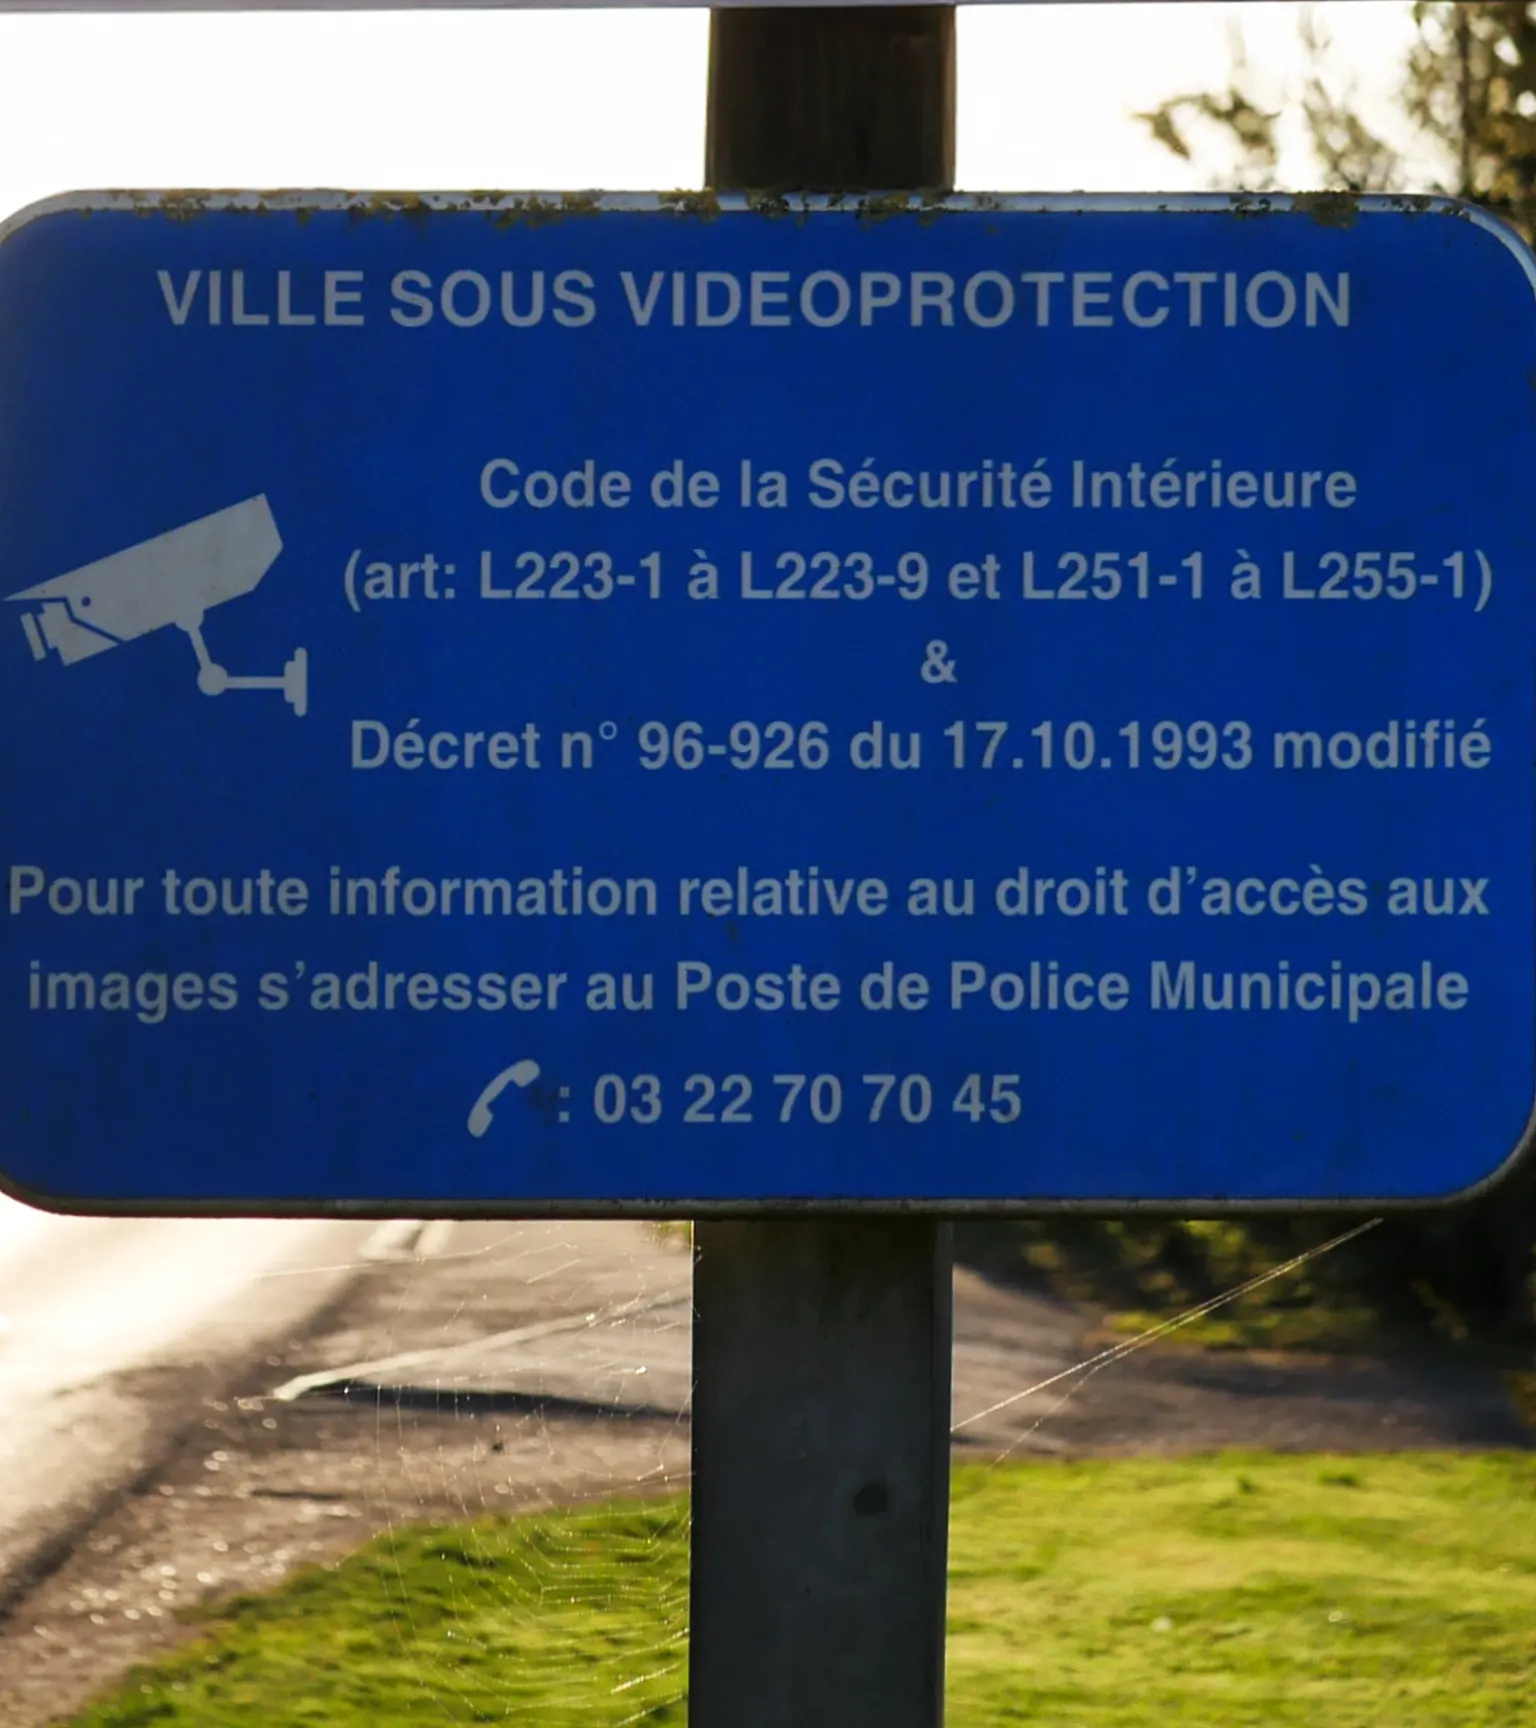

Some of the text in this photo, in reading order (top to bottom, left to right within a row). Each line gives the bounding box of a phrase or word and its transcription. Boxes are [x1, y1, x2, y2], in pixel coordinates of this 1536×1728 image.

[159, 270, 1349, 327] VILLE SOUS VIDEOPROTECTION
[480, 459, 1357, 508] Code de la Sécurité Intérieure
[344, 549, 1493, 611] (art: L223-1 à L223-9 et L251-1 à L255-1)
[921, 640, 956, 683] &
[352, 718, 1491, 770] Décret n° 96-926 du 17.10.1993 modifié
[10, 866, 144, 914] Pour
[163, 870, 308, 915] toute
[330, 866, 656, 915] information
[680, 867, 888, 916] relative
[908, 878, 974, 916] au
[996, 867, 1127, 915] droit
[1388, 878, 1489, 915] aux
[30, 960, 237, 1022] images
[586, 973, 653, 1010] au
[677, 961, 840, 1010] Poste
[861, 962, 929, 1010] de
[951, 961, 1129, 1010] Police
[1151, 961, 1469, 1022] Municipale
[594, 1075, 662, 1123] 03
[684, 1075, 753, 1123] 22
[774, 1074, 843, 1123] 70
[863, 1074, 933, 1123] 70
[953, 1074, 1022, 1123] 45
